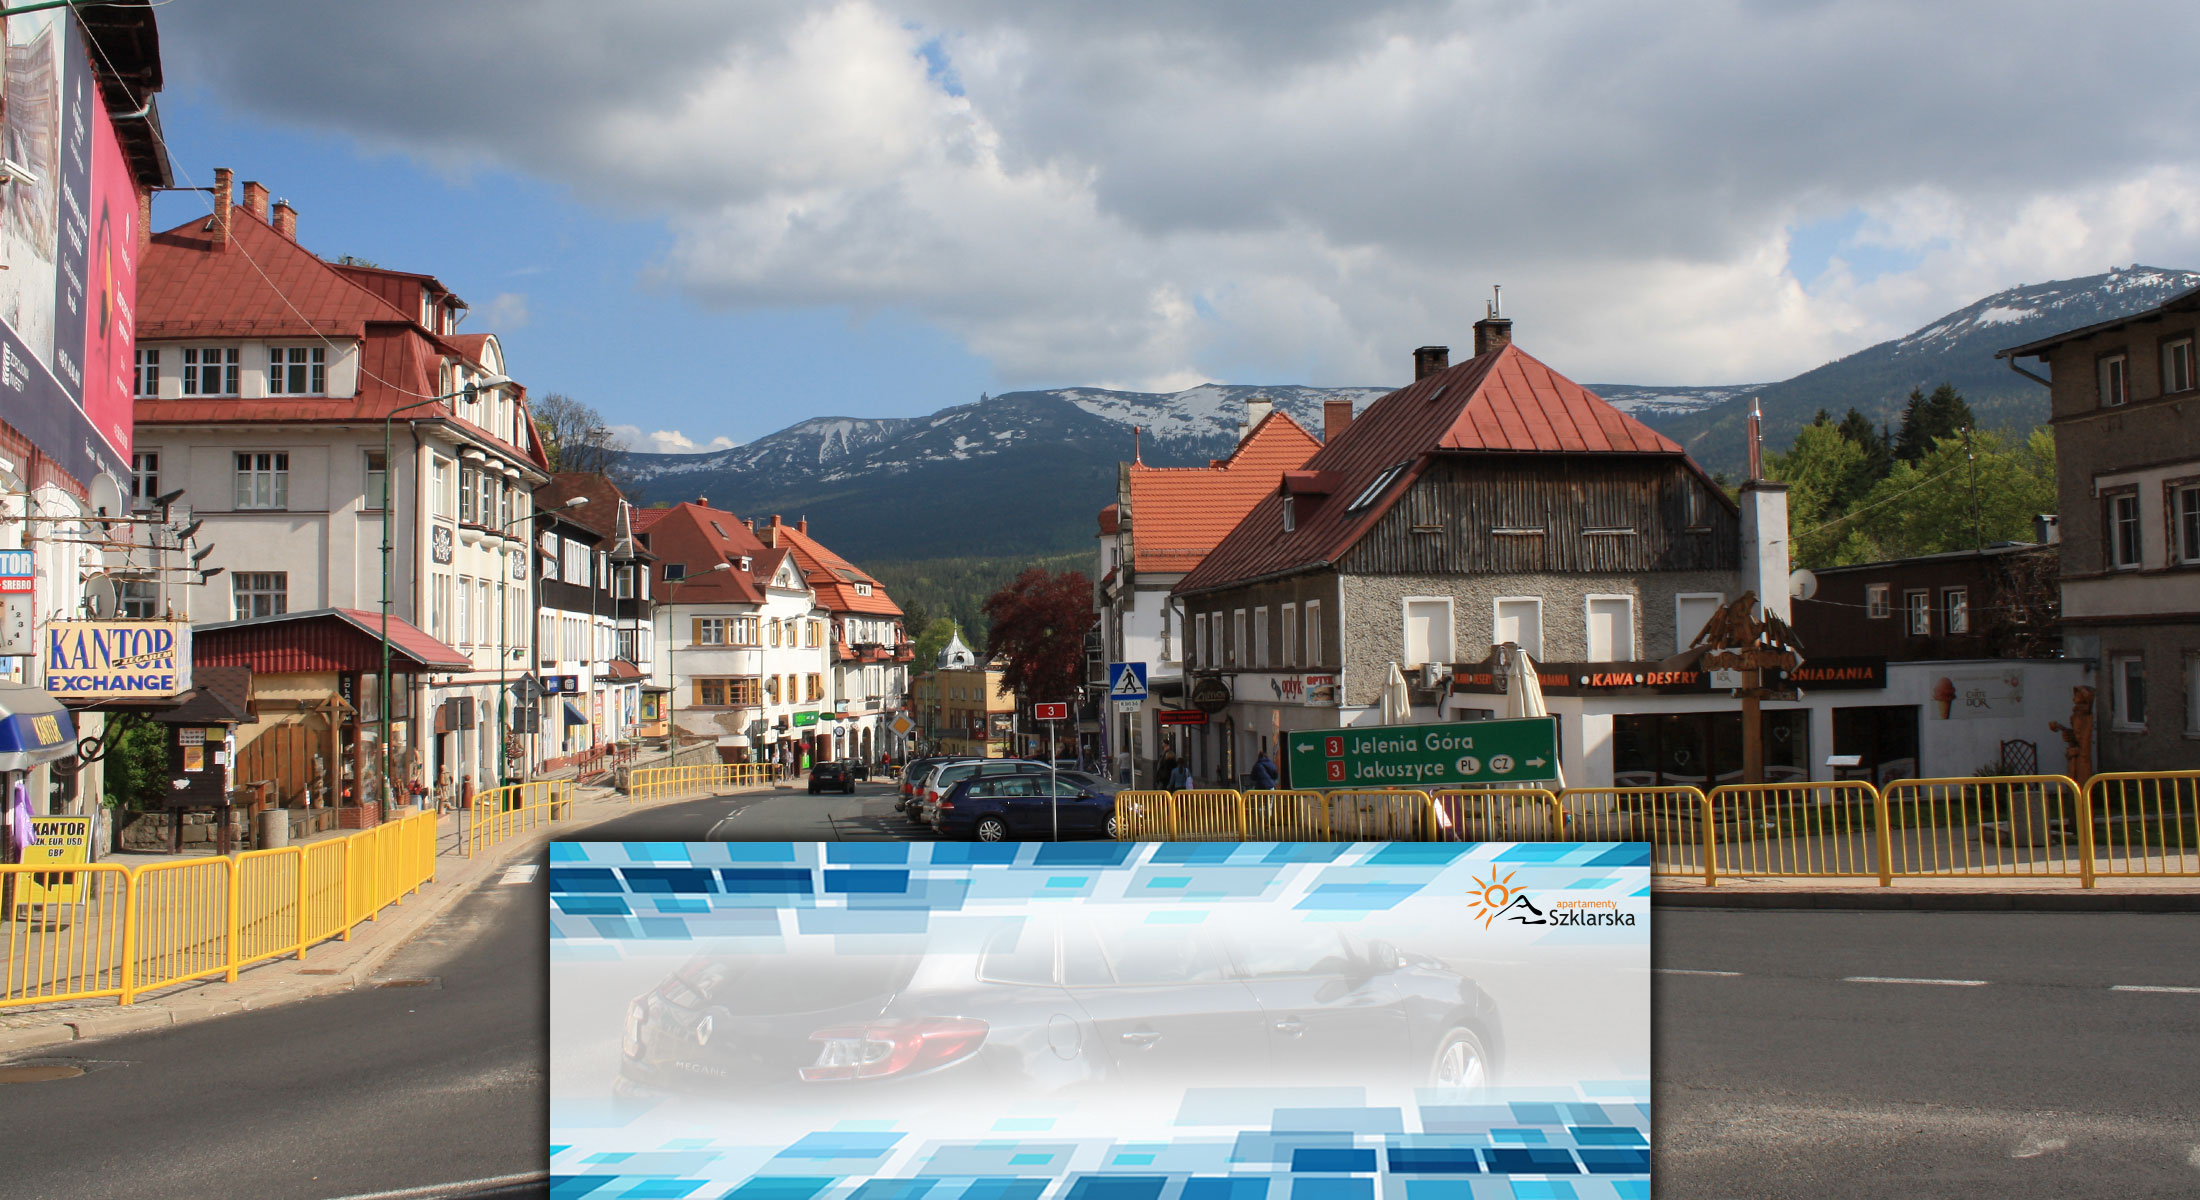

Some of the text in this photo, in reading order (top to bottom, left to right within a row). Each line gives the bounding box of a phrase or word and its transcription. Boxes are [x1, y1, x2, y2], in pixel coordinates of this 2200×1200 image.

[2, 579, 32, 590] SREBRO
[49, 628, 174, 670] KANTOR
[47, 675, 174, 691] EXCHANGE
[1592, 671, 1700, 687] KAWA DESERY
[1281, 675, 1303, 700] optyk
[1047, 706, 1055, 716] 3
[32, 714, 64, 746] KANTOR
[1330, 732, 1474, 755] 3 Jelenia Góra
[1331, 757, 1509, 781] 3 Jakuszyce PL CZ
[32, 822, 85, 836] KANTOR
[48, 848, 64, 857] GBP
